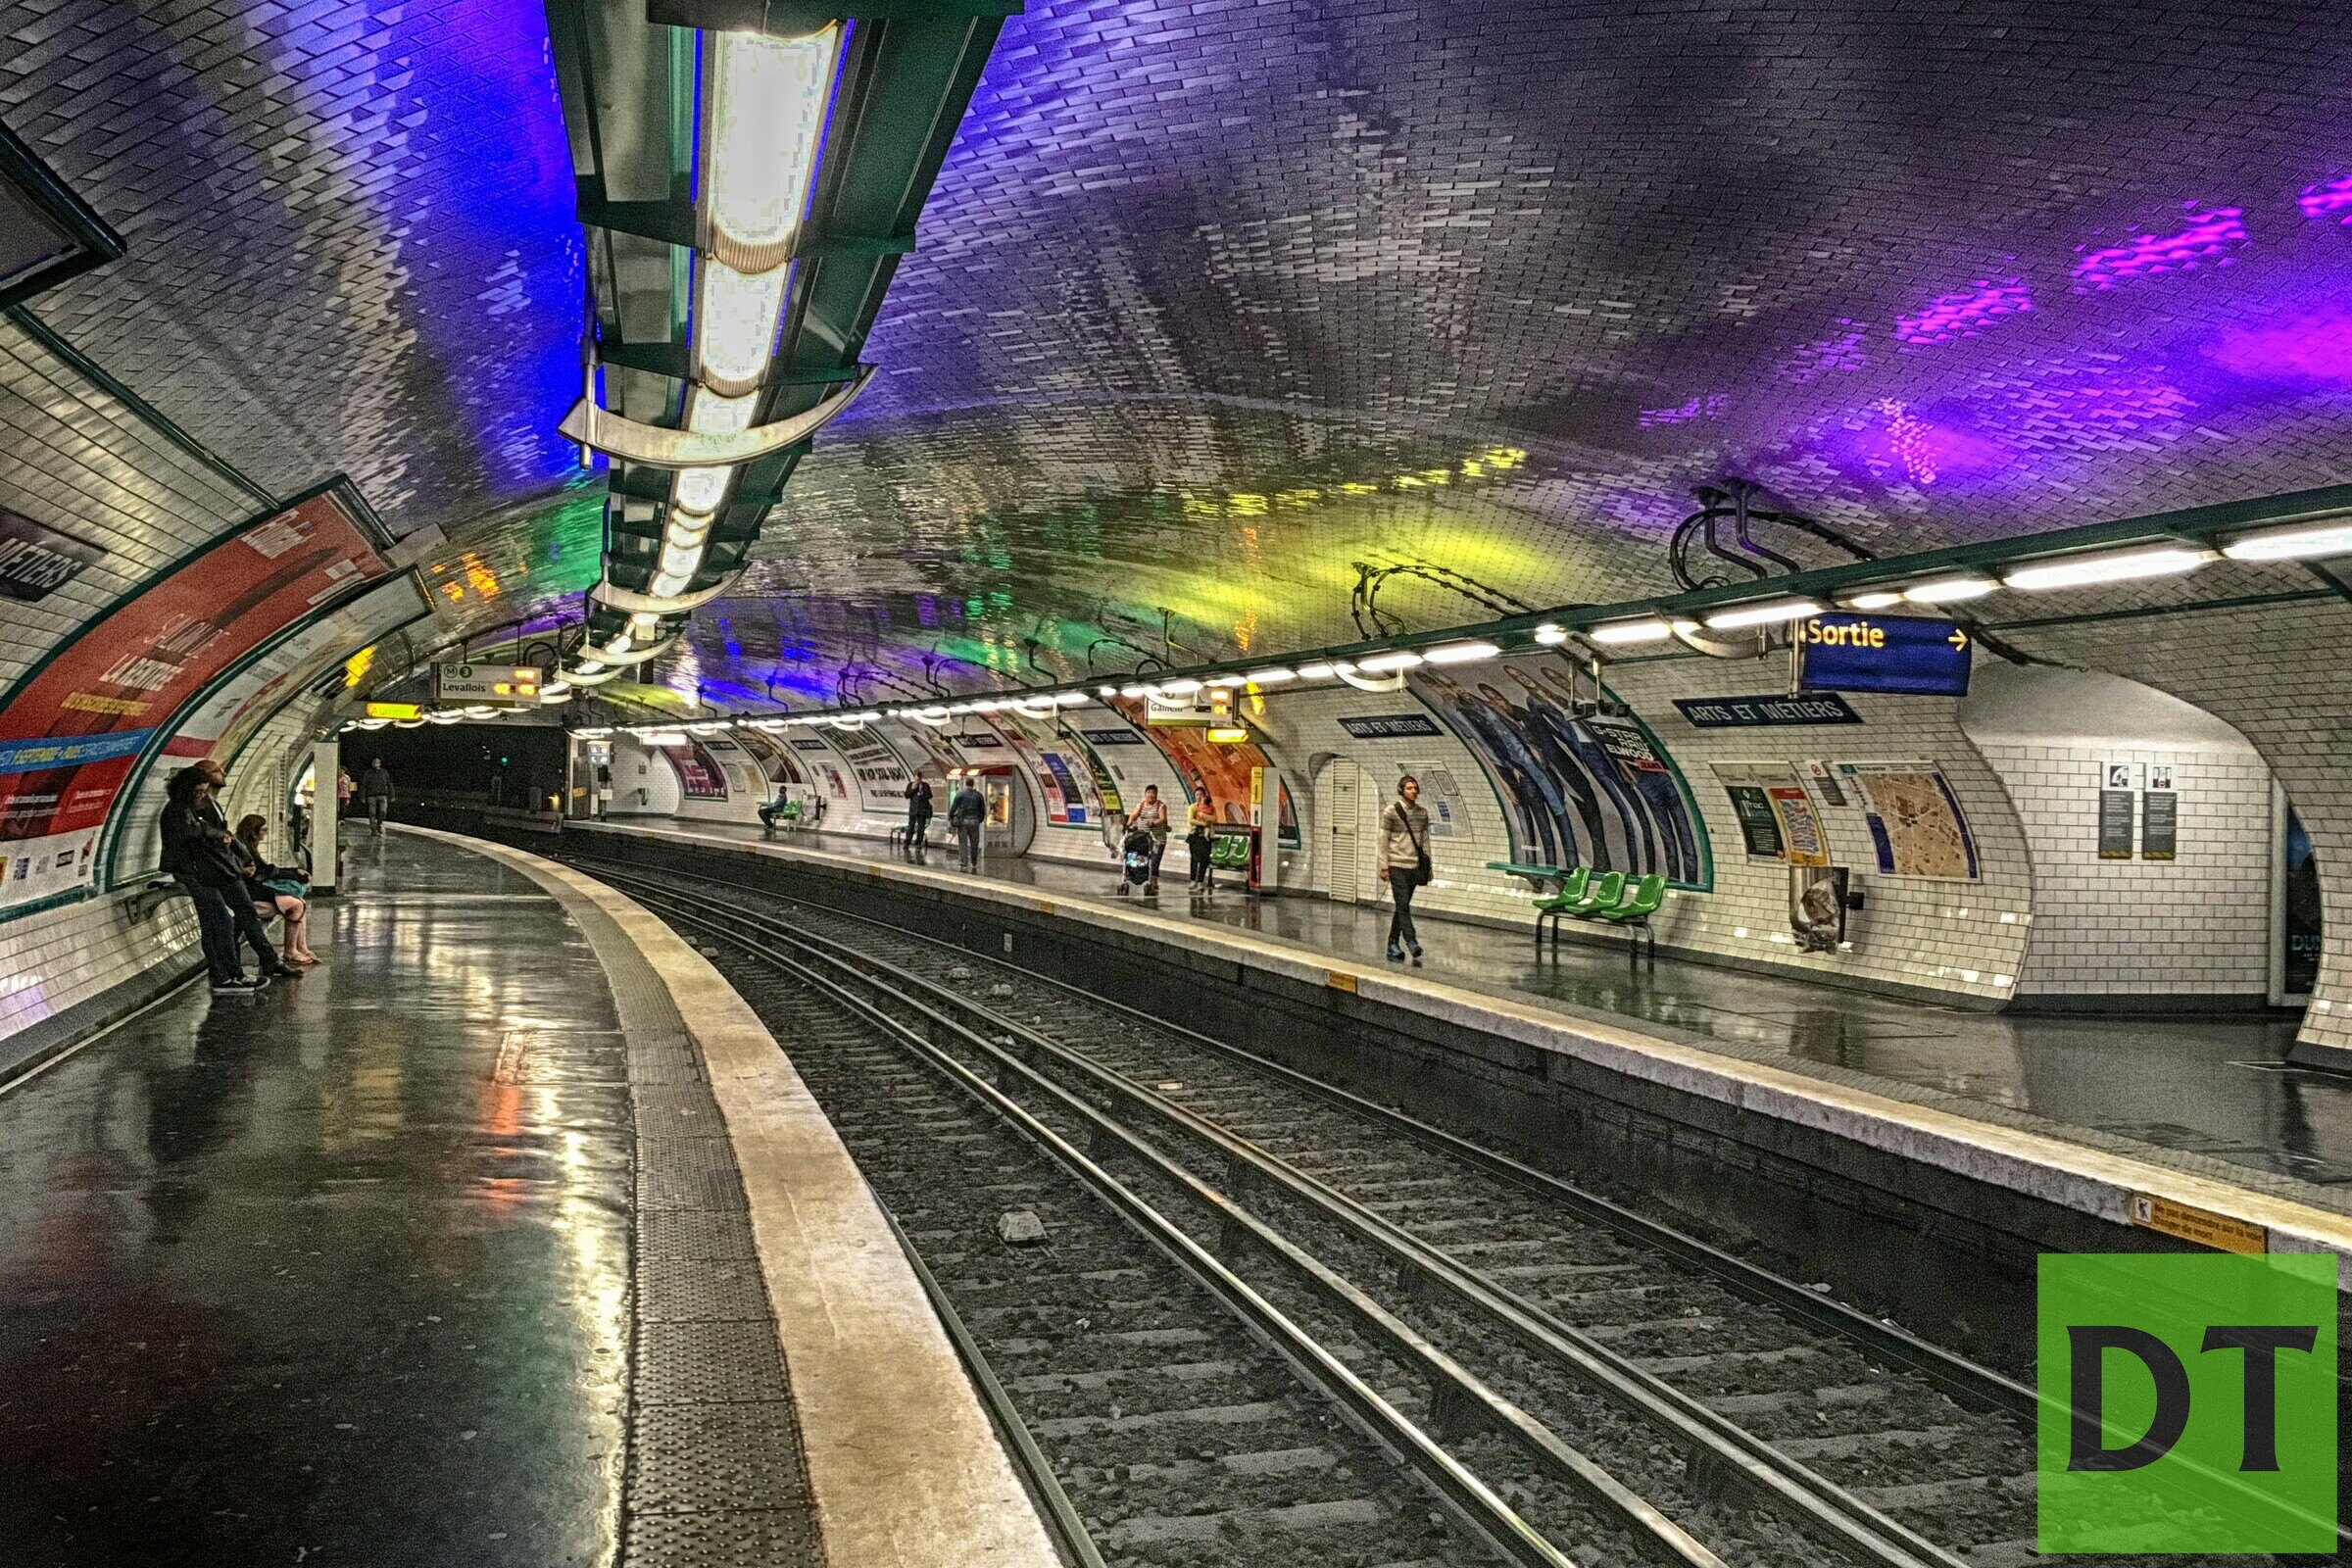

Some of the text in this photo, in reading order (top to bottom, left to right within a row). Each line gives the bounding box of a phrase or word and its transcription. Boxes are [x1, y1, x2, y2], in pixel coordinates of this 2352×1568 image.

[1808, 619, 1885, 648] Sortie
[443, 683, 486, 693] Levallois
[1687, 700, 1843, 721] ARTS ET MÉTIERS
[1347, 718, 1433, 734] ARTS ET MÉTIERS
[1605, 744, 1654, 761] ELWOOD
[1617, 738, 1649, 753] RAW
